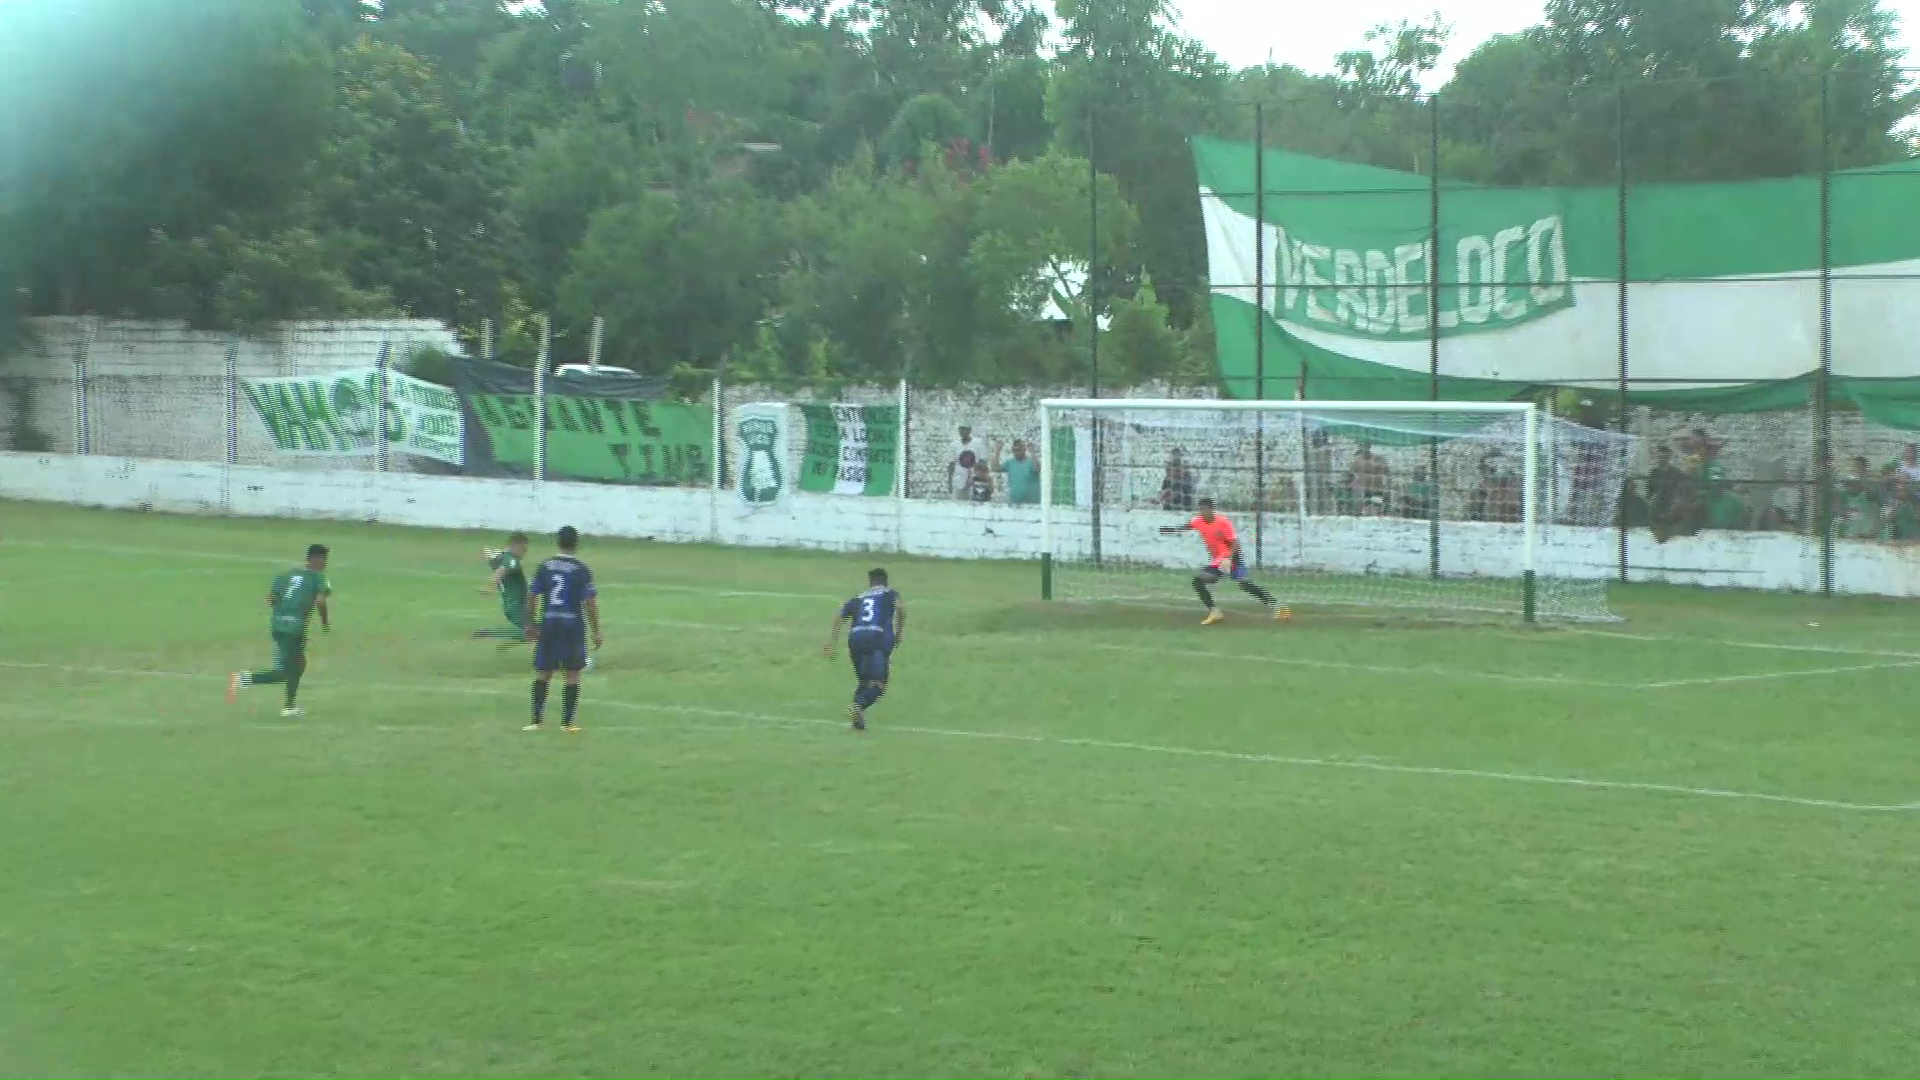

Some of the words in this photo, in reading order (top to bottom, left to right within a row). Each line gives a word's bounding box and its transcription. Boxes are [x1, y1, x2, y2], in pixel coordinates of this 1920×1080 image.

[1276, 227, 1427, 333] VERDE
[1423, 215, 1566, 329] LOCO
[409, 383, 460, 412] TODOS
[283, 575, 302, 599] 7
[551, 573, 565, 605] 2
[861, 599, 875, 622] 3
